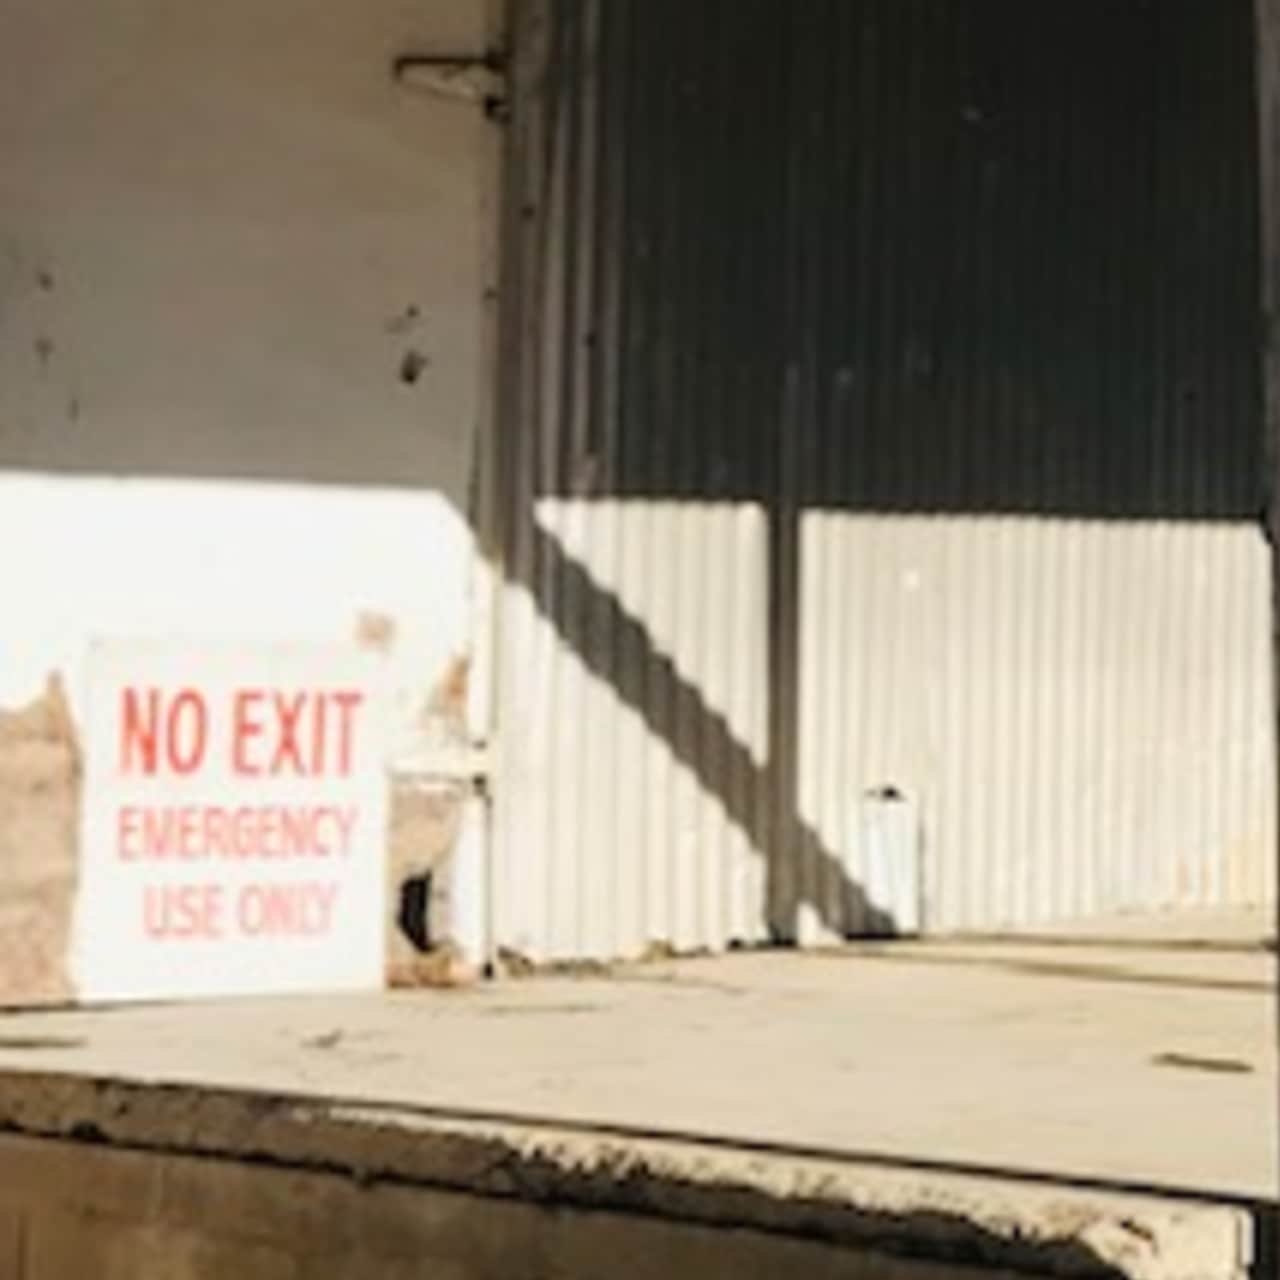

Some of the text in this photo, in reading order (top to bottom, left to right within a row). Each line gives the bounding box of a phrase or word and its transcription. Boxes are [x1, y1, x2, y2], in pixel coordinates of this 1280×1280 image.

[120, 687, 363, 777] NO EXIT
[118, 806, 357, 860] EMERGENCY
[142, 883, 338, 937] USE ONLY
